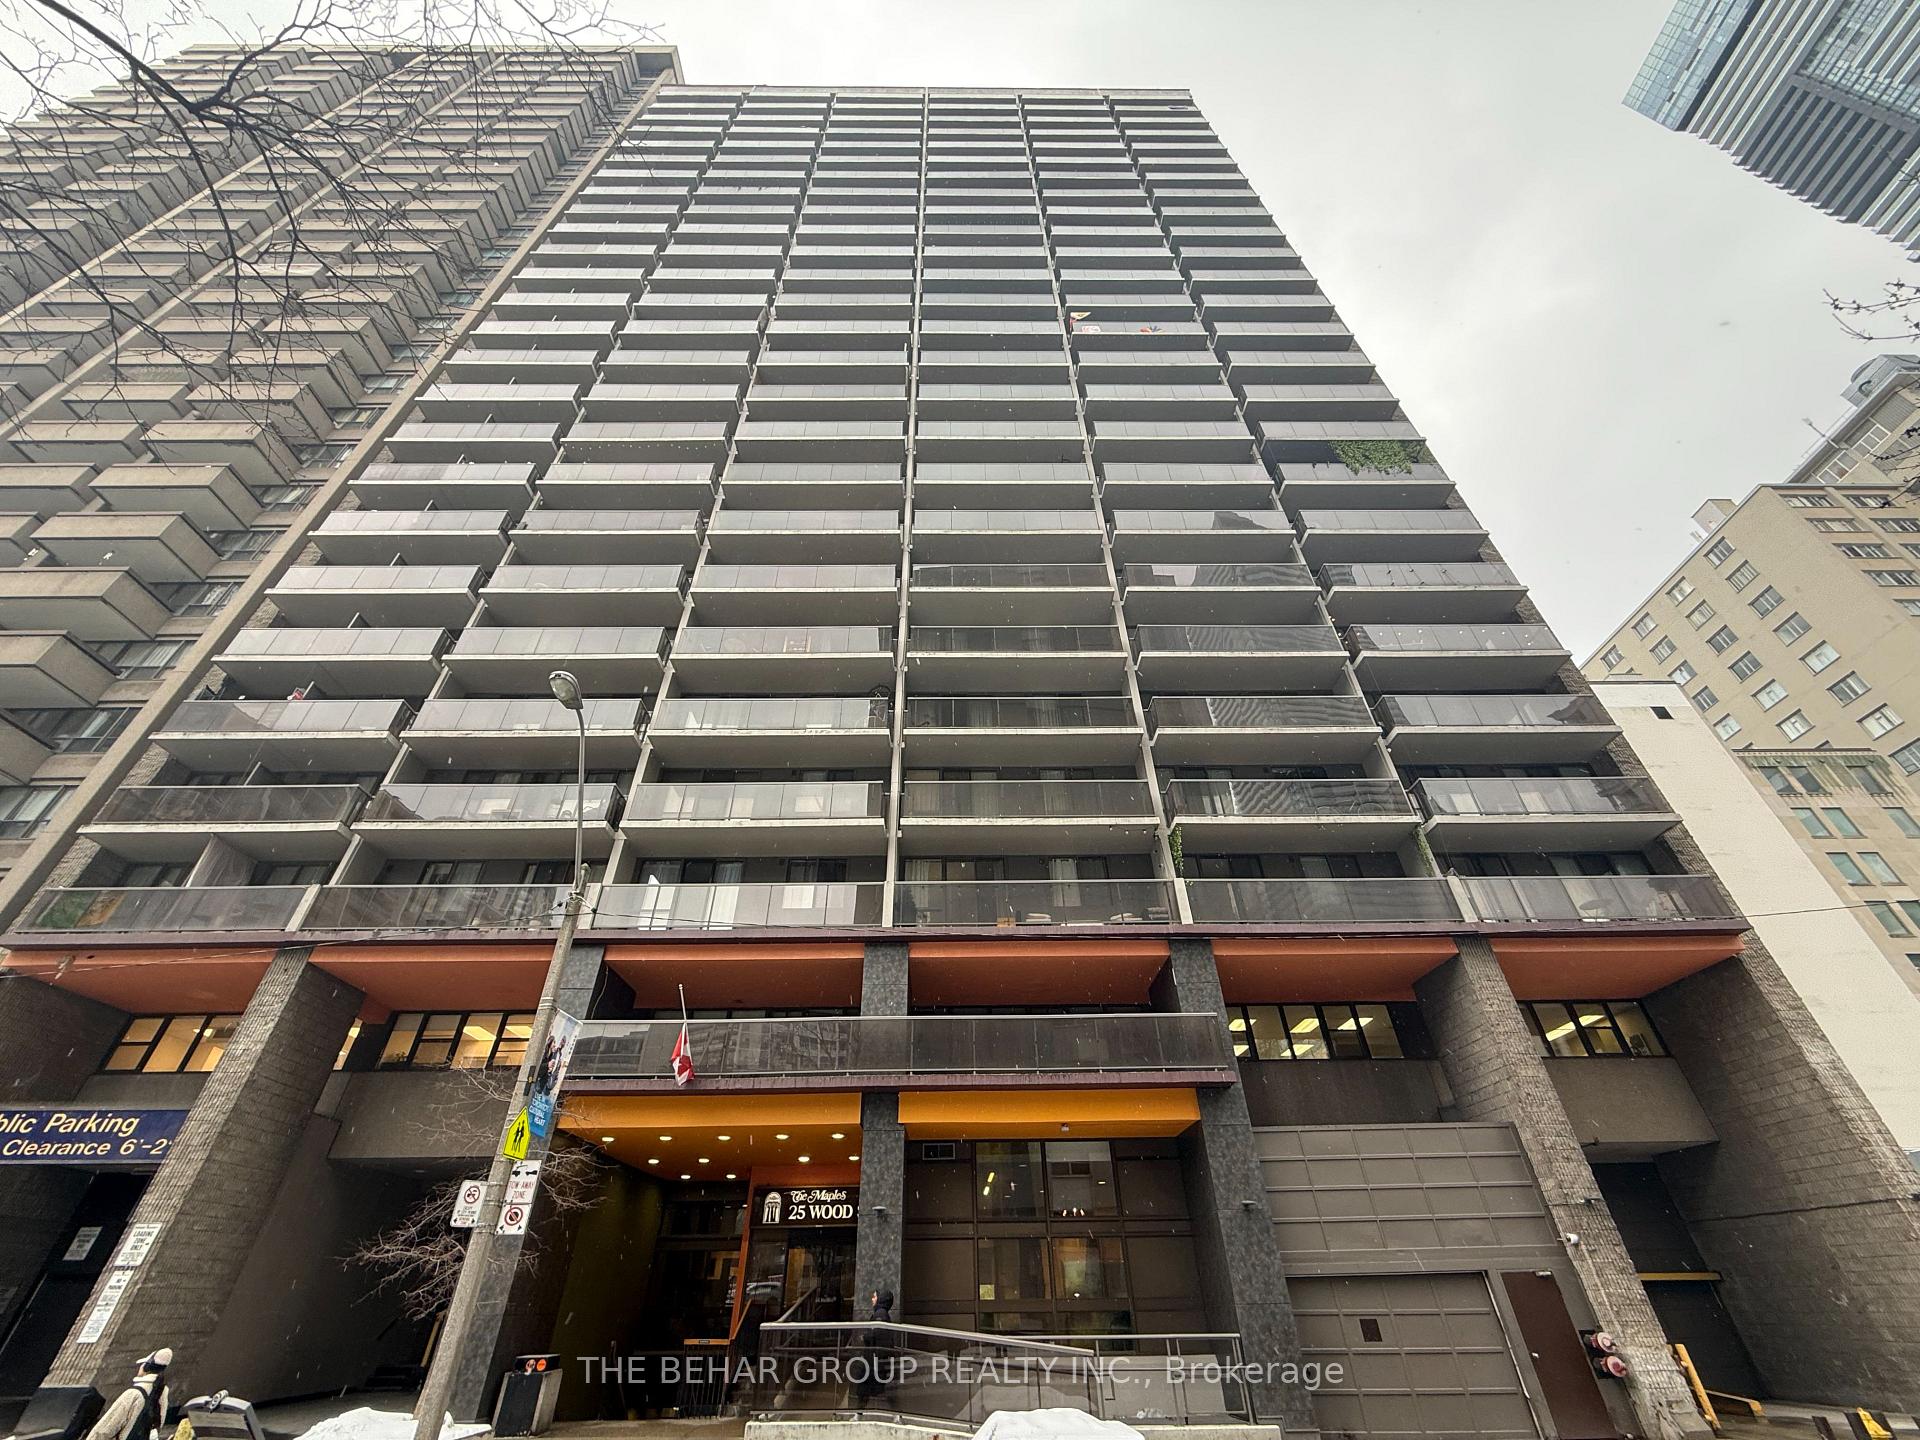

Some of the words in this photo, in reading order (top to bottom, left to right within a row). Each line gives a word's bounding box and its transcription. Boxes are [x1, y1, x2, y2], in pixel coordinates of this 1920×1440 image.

[43, 1113, 140, 1137] Parking
[3, 1139, 111, 1156] Clearance
[509, 1181, 519, 1189] TOW
[521, 1181, 535, 1190] AWAY
[513, 1190, 526, 1199] ZONE
[791, 1190, 808, 1203] The
[807, 1189, 847, 1203] Maples
[788, 1204, 806, 1220] 25
[809, 1204, 854, 1219] WOOD
